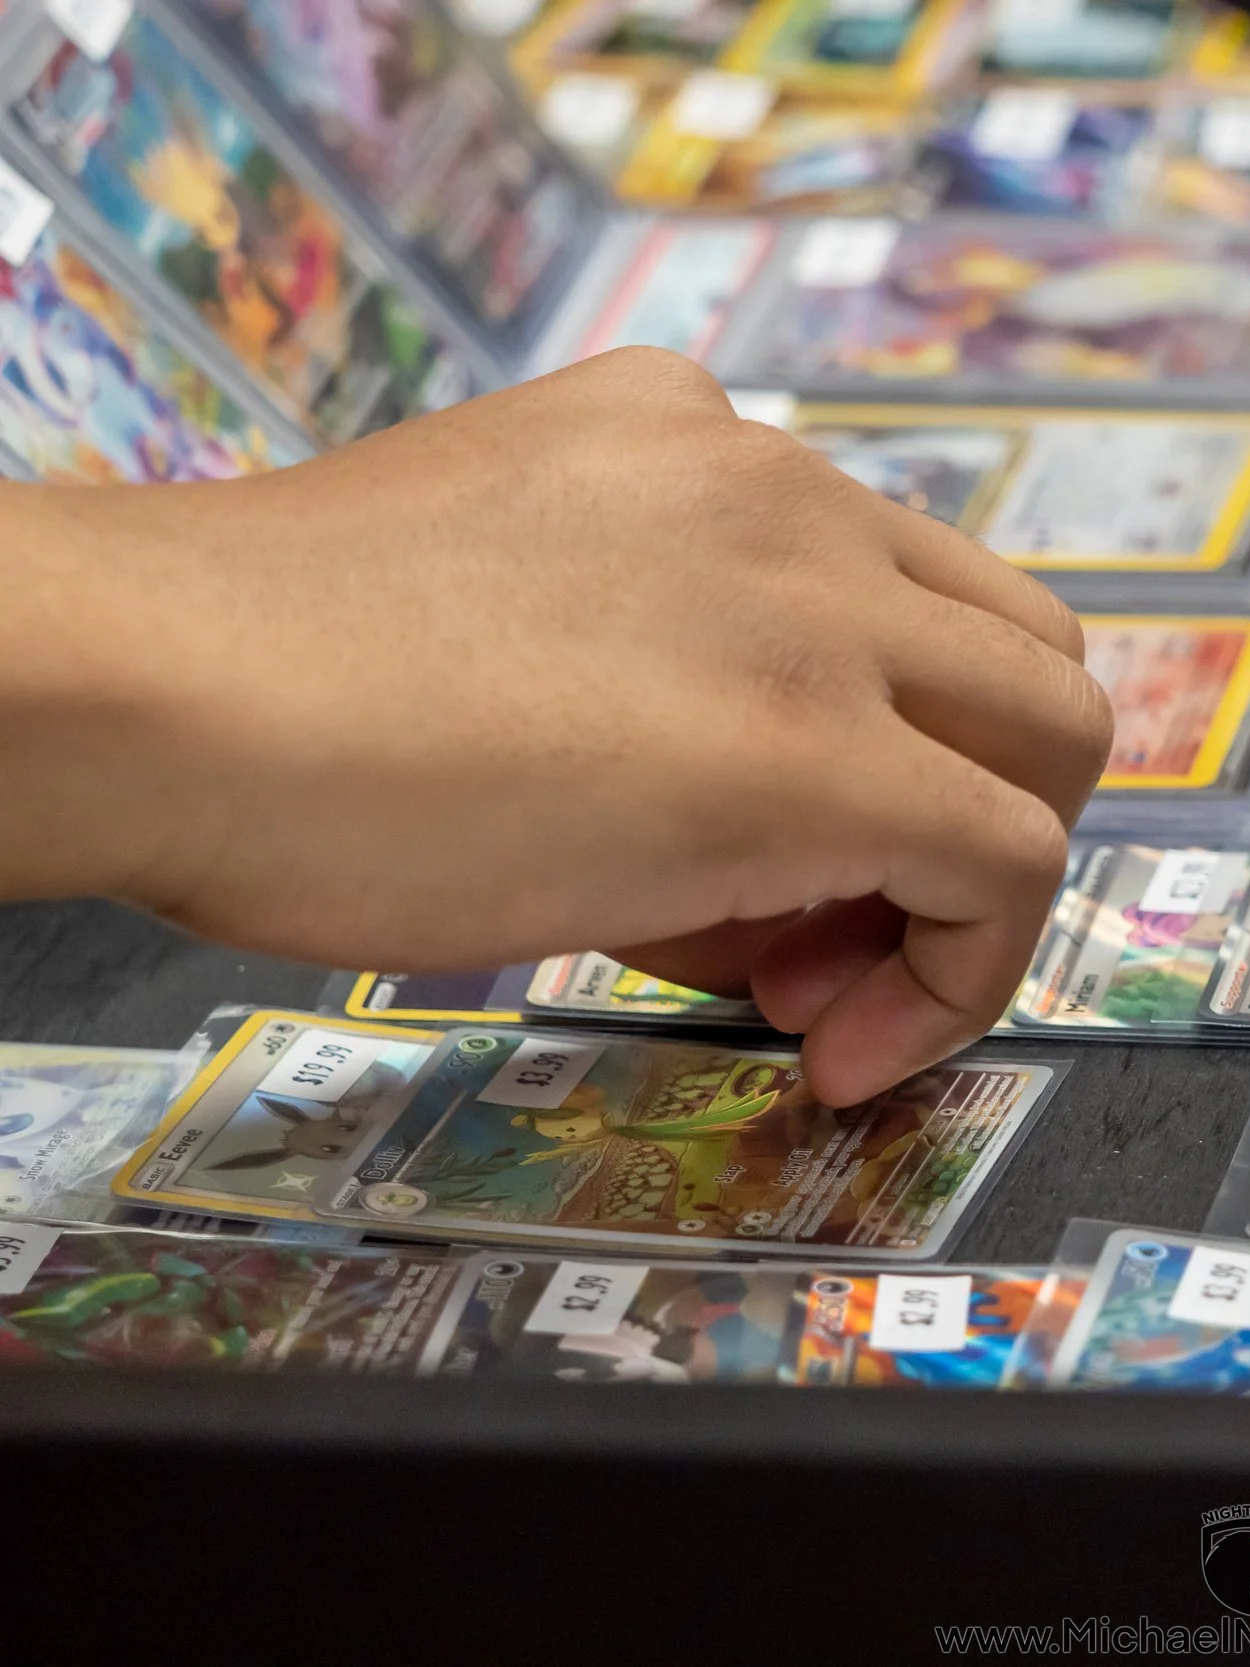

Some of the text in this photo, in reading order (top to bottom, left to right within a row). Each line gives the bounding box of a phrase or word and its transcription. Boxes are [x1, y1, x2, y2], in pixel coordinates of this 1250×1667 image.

[1065, 973, 1100, 1013] Miriam
[291, 1043, 353, 1086] $19.99
[515, 1052, 569, 1087] $3.99
[18, 1128, 72, 1181] Snow Mirage
[157, 1127, 203, 1162] Eevee
[359, 1144, 407, 1180] Dolliv
[142, 1166, 166, 1190] BASIC
[713, 1163, 746, 1184] Slap
[770, 1147, 815, 1188] Apply Oil
[561, 1274, 615, 1313] $2.99
[898, 1288, 940, 1327] $2.99
